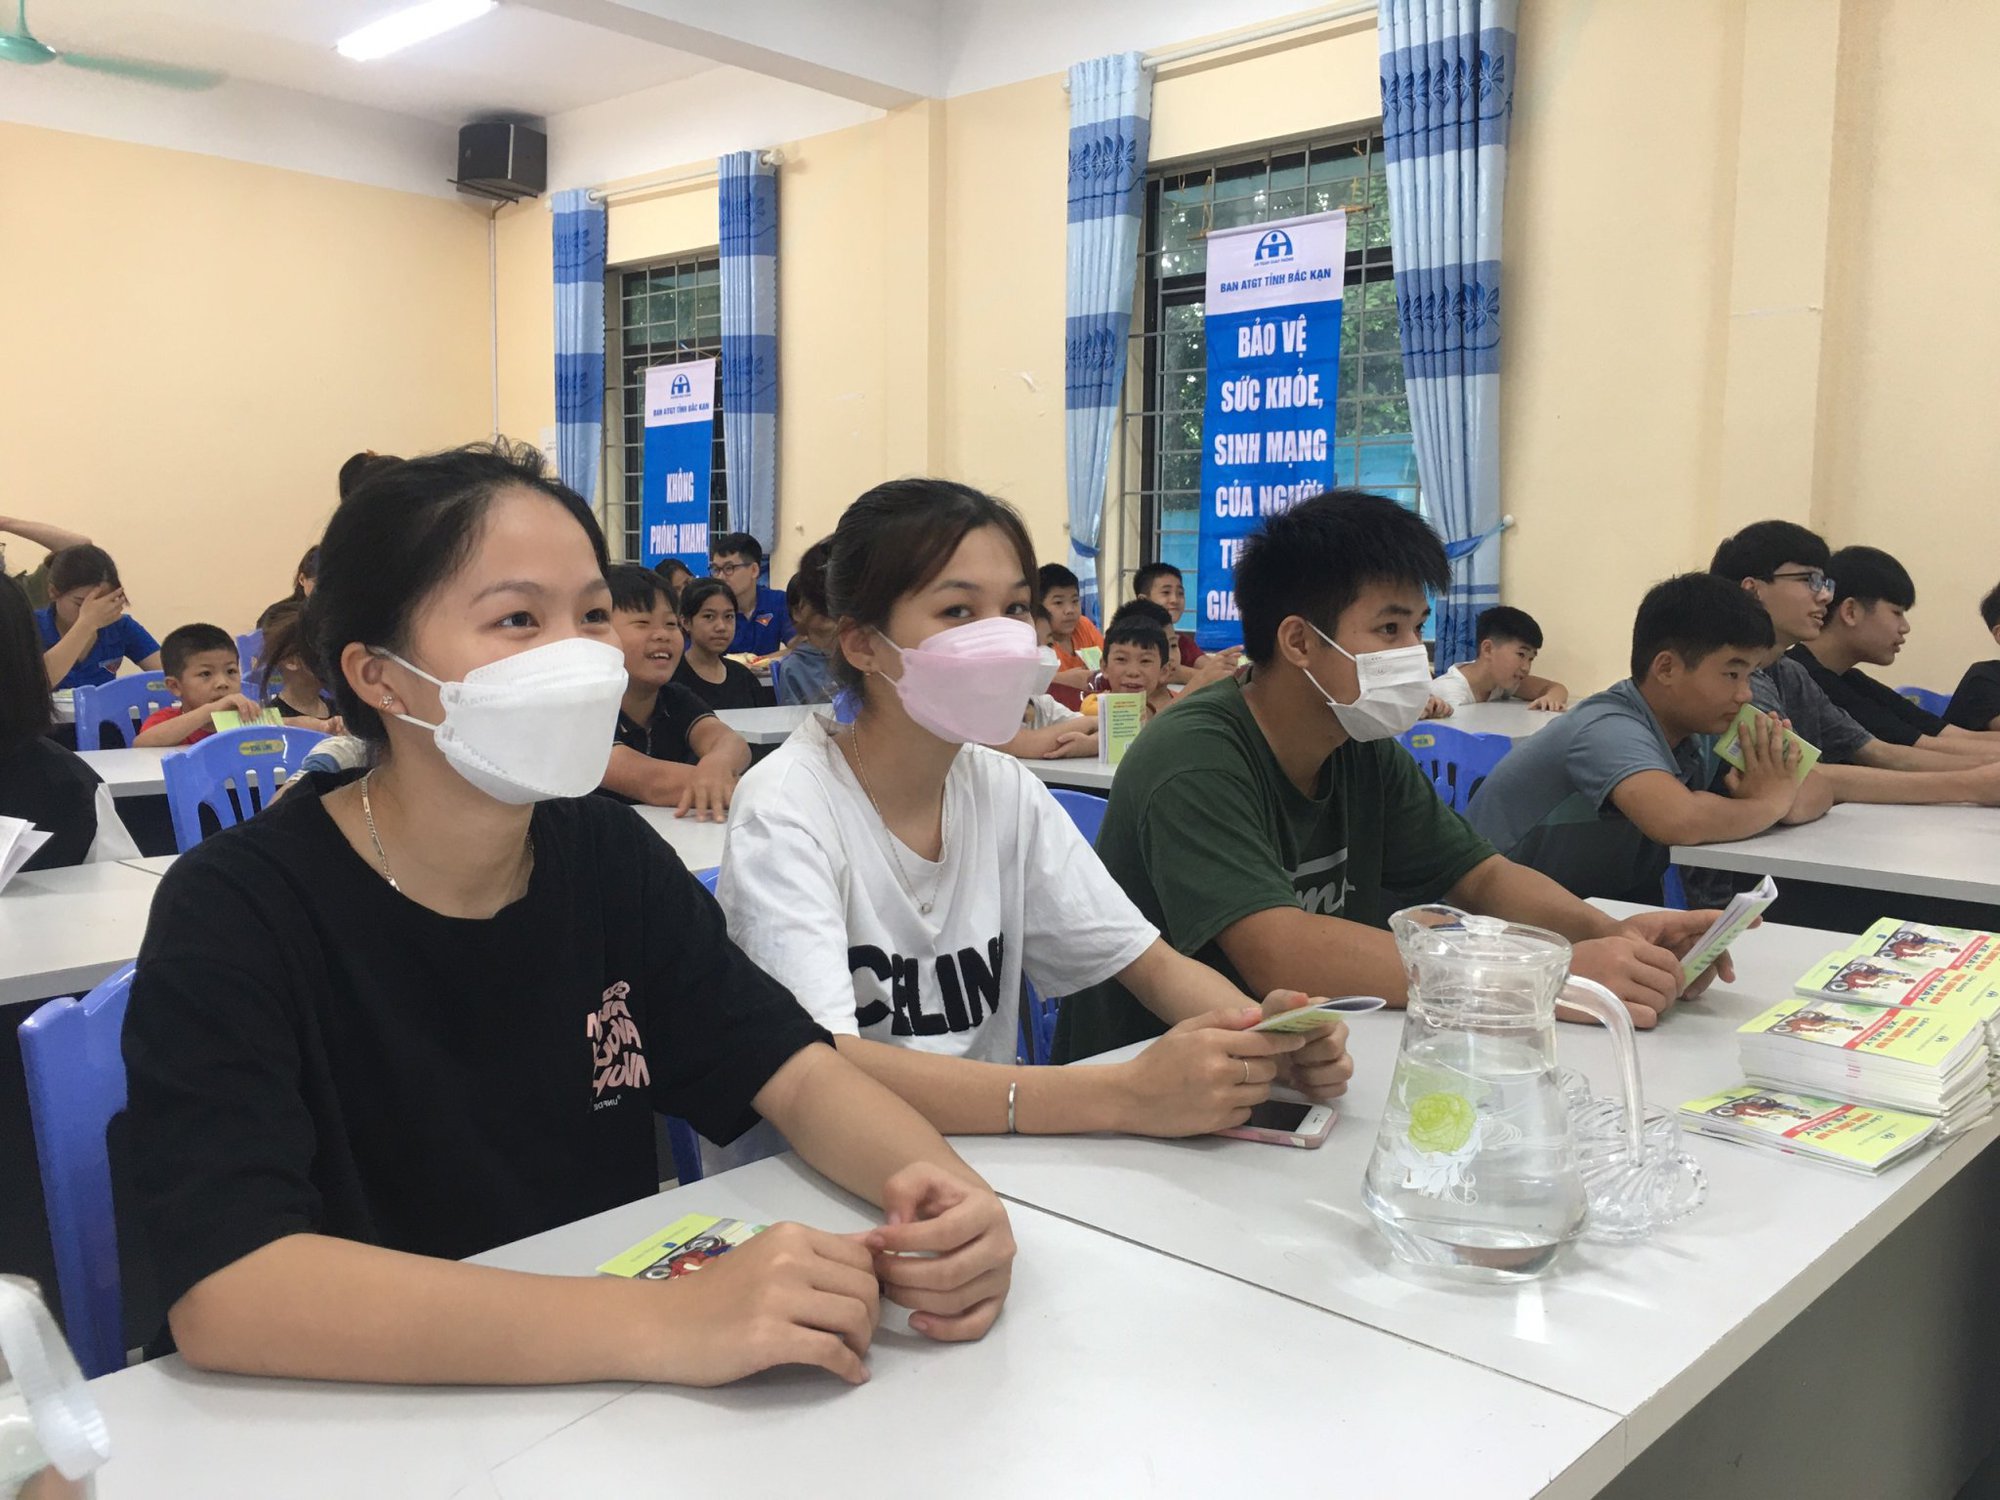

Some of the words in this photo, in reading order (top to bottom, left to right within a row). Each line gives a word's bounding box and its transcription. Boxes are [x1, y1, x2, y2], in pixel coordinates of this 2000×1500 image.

[1220, 280, 1239, 293] BAN
[1241, 277, 1262, 290] ATGT
[1310, 268, 1332, 282] KẠN
[1237, 317, 1276, 358] BẢO
[1281, 314, 1307, 358] VỆ
[1220, 374, 1261, 413] SỨC
[1265, 367, 1324, 410] KHỎE,
[1214, 432, 1261, 466] SINH
[1265, 428, 1327, 468] MẠNG
[1215, 479, 1254, 518] CỦA
[650, 520, 678, 555] PHÓNG
[1206, 590, 1242, 621] GIA
